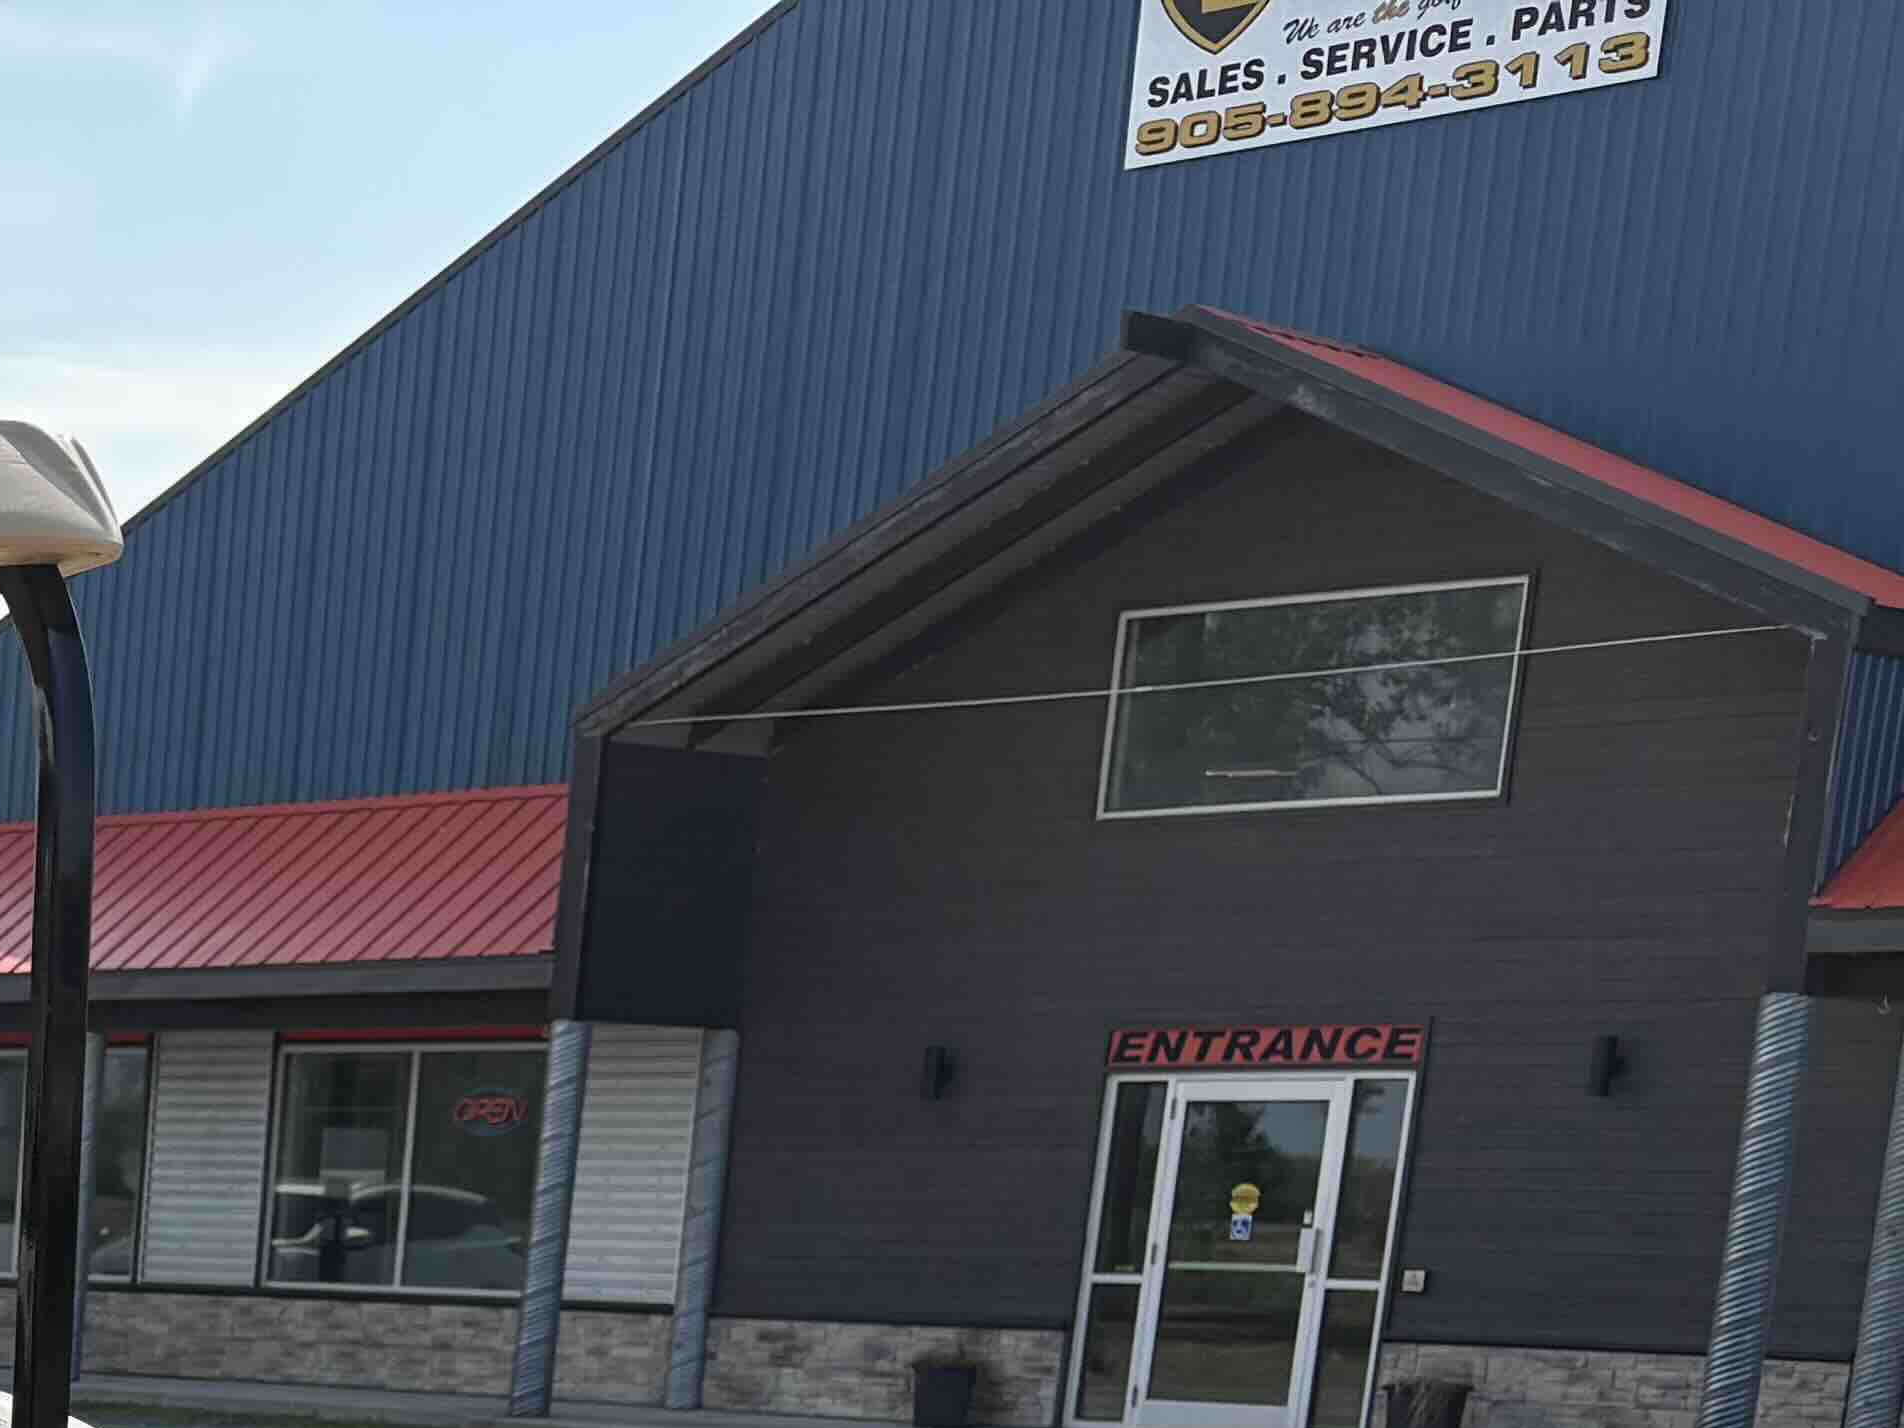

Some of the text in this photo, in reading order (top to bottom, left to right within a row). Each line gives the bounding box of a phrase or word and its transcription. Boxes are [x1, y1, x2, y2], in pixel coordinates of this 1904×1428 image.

[1147, 0, 1650, 107] SALES SERVICE PARTS
[1282, 17, 1320, 45] We
[1327, 12, 1367, 34] are
[1135, 30, 1650, 156] 905-894-3113
[1110, 1026, 1423, 1065] ENTRANCE
